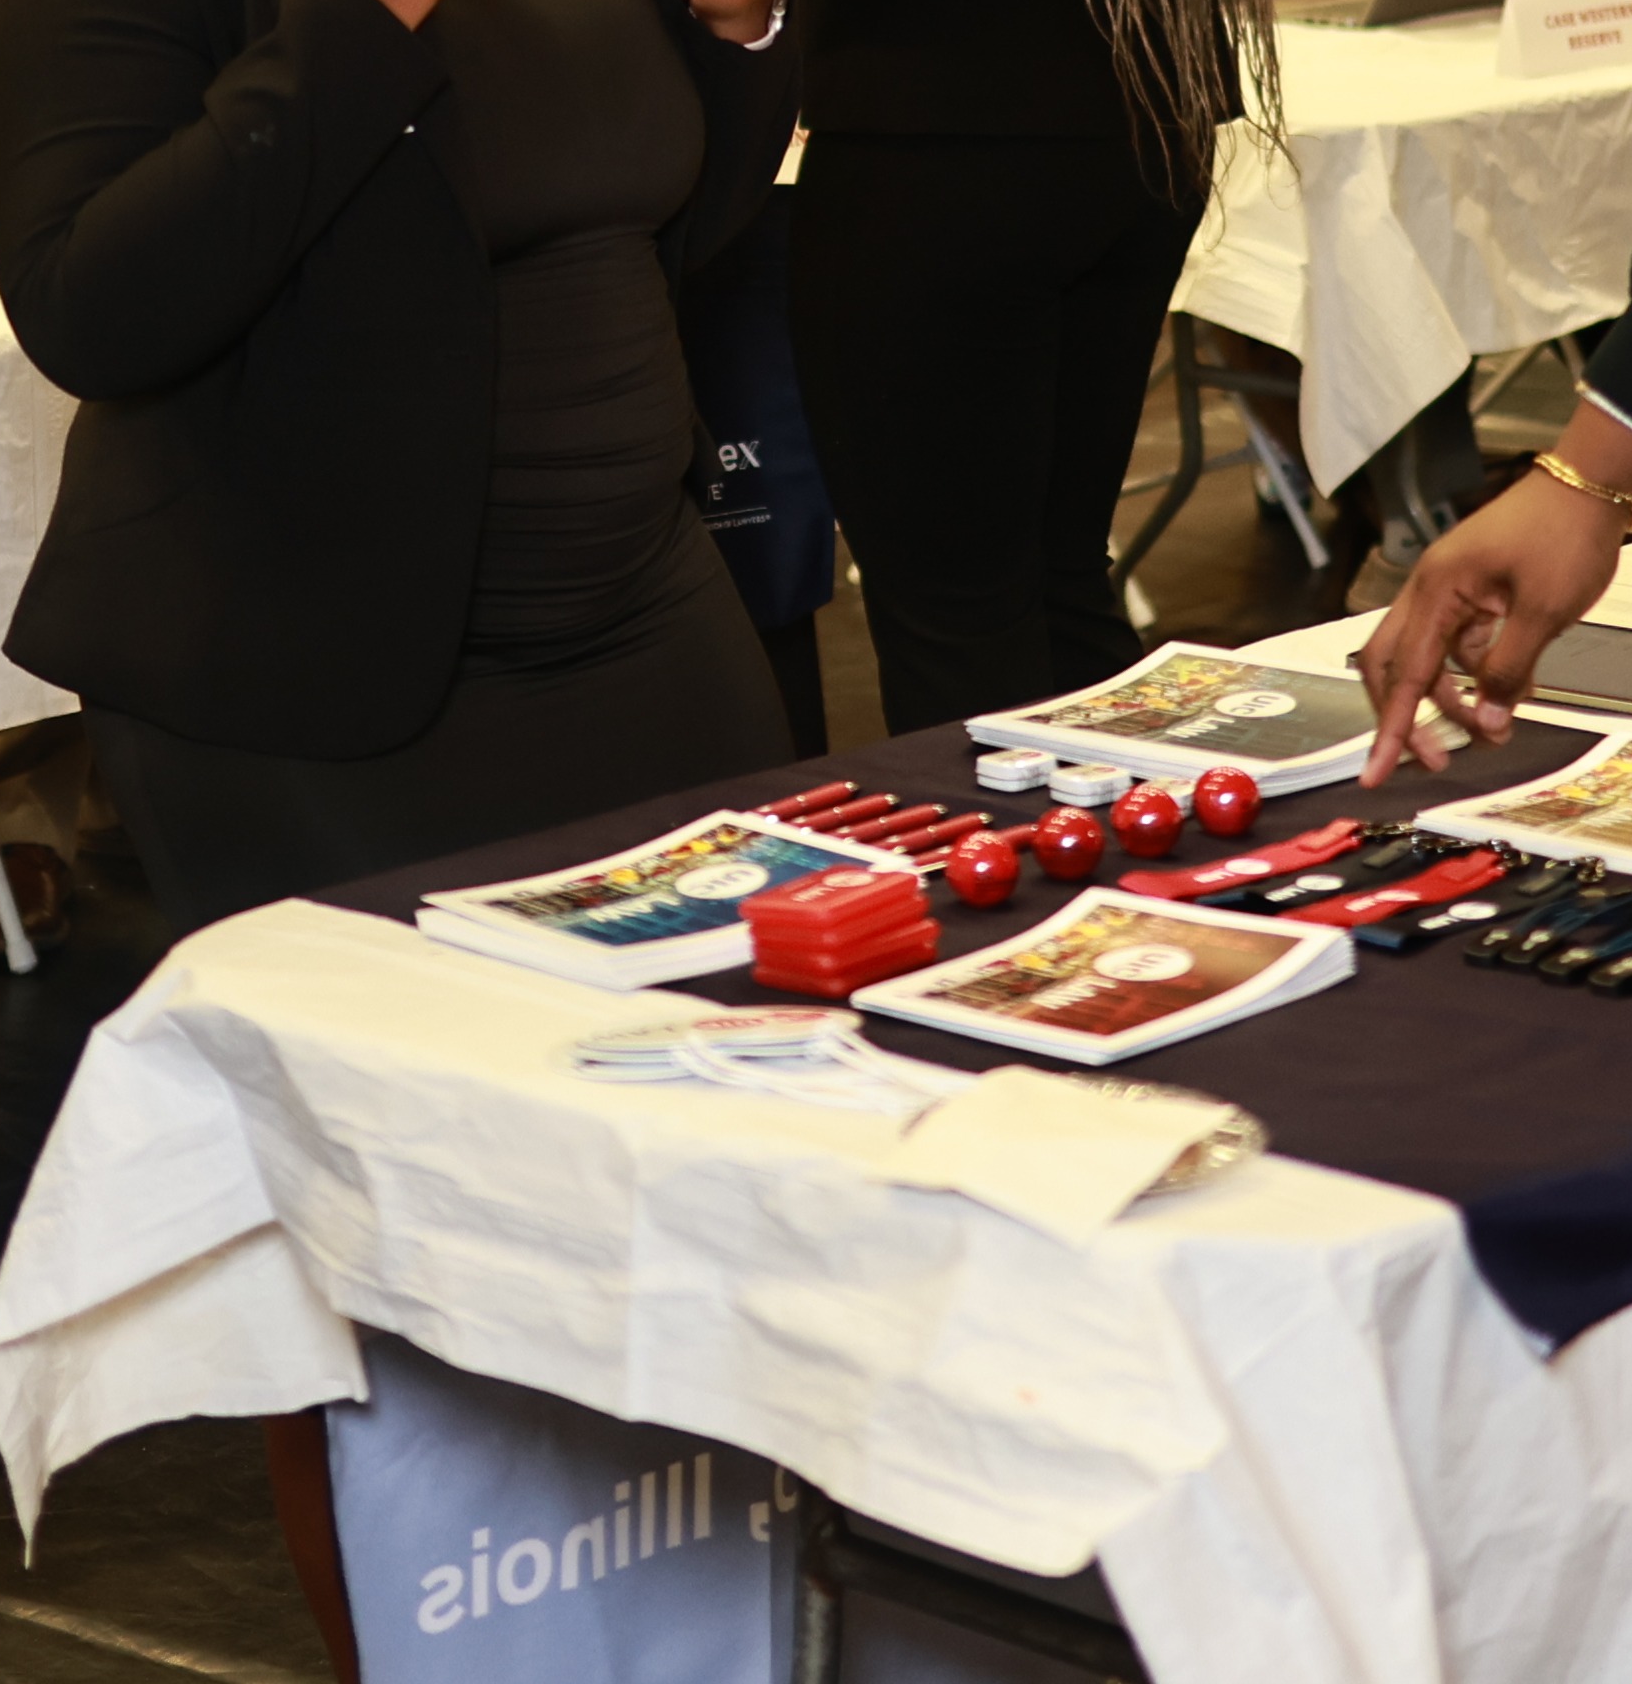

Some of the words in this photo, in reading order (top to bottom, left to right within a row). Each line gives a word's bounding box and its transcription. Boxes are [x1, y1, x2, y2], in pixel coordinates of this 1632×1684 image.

[1568, 30, 1621, 49] RESERVE
[1165, 716, 1235, 739] LAW
[1030, 974, 1118, 1010] LAW
